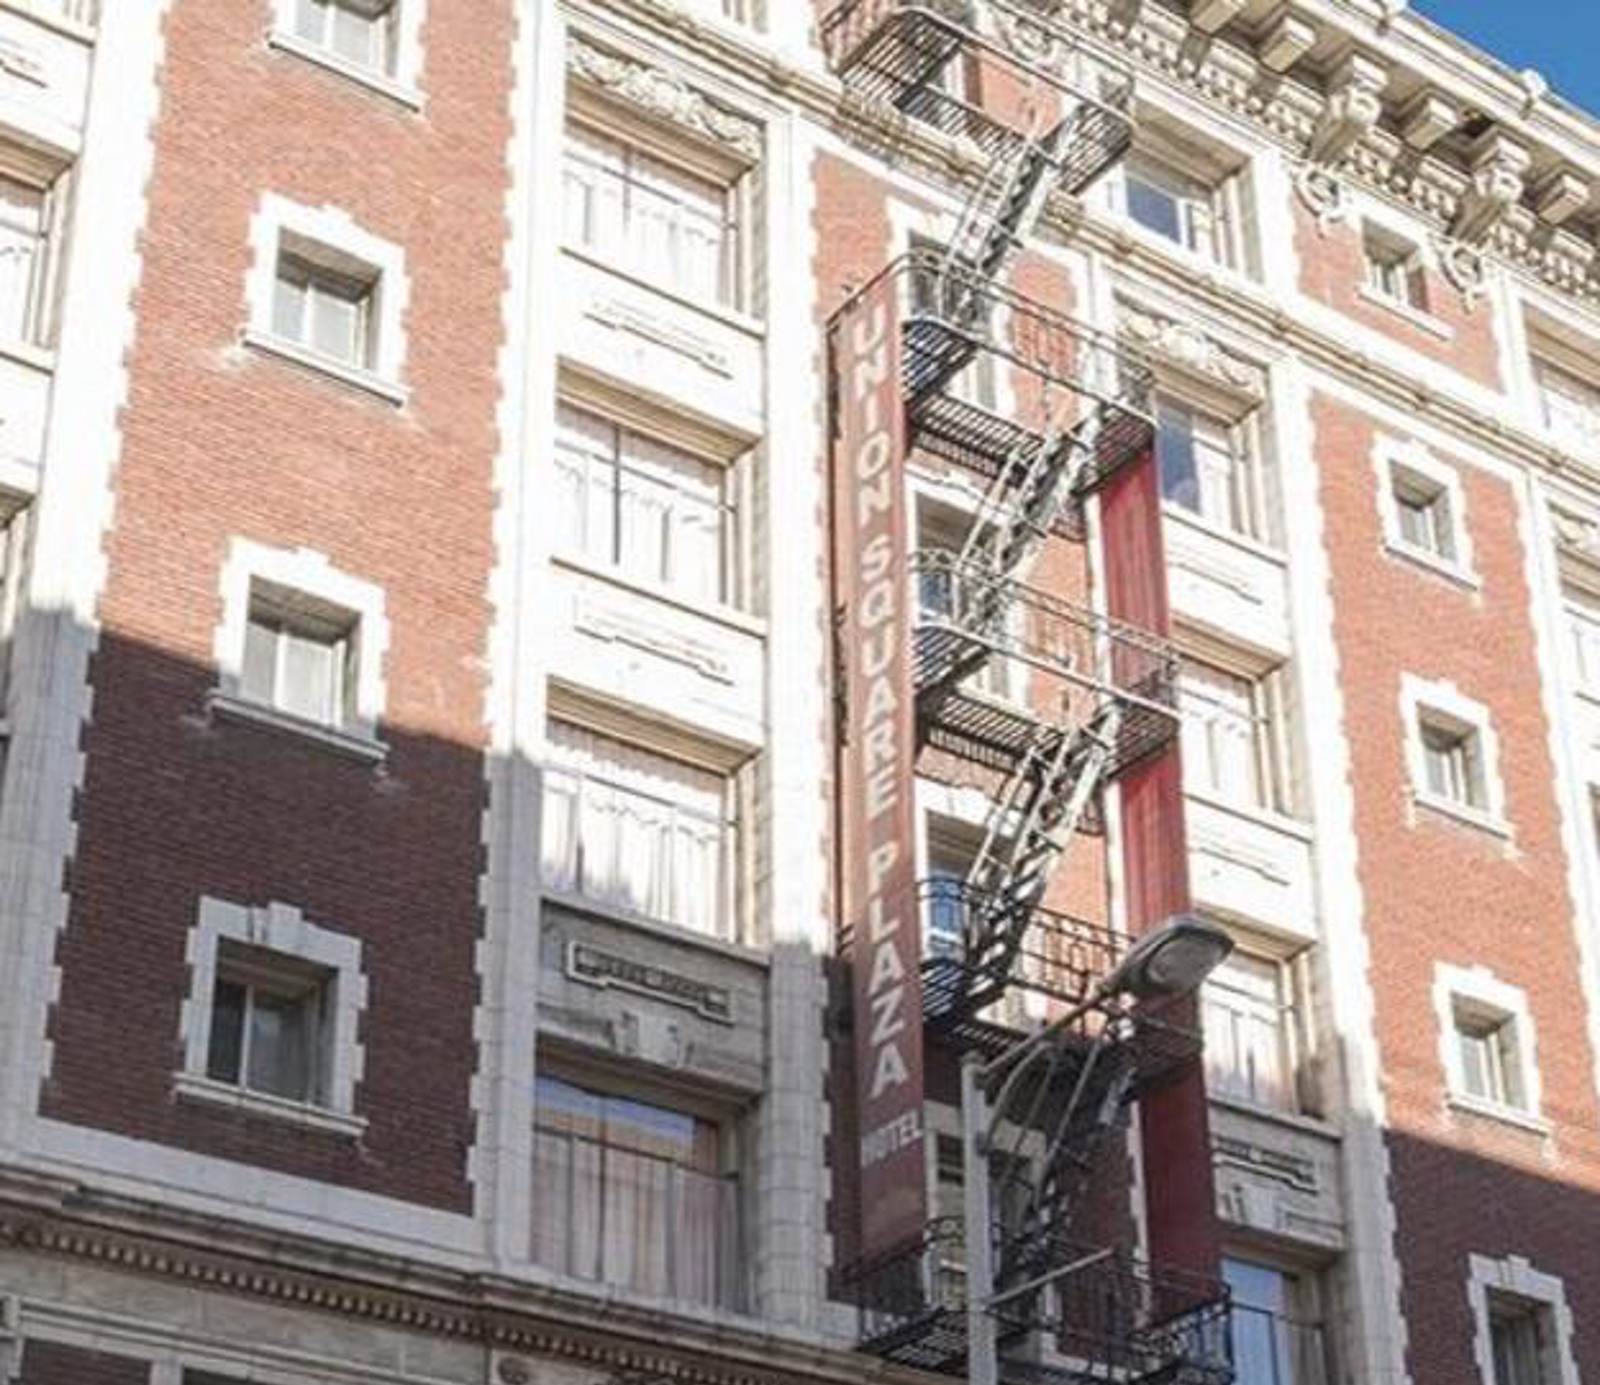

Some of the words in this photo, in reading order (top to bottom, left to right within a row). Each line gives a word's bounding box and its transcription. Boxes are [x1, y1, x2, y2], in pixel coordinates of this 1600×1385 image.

[854, 303, 890, 528] UNION
[861, 534, 898, 820] SQUARE
[869, 841, 908, 1098] PLAZA
